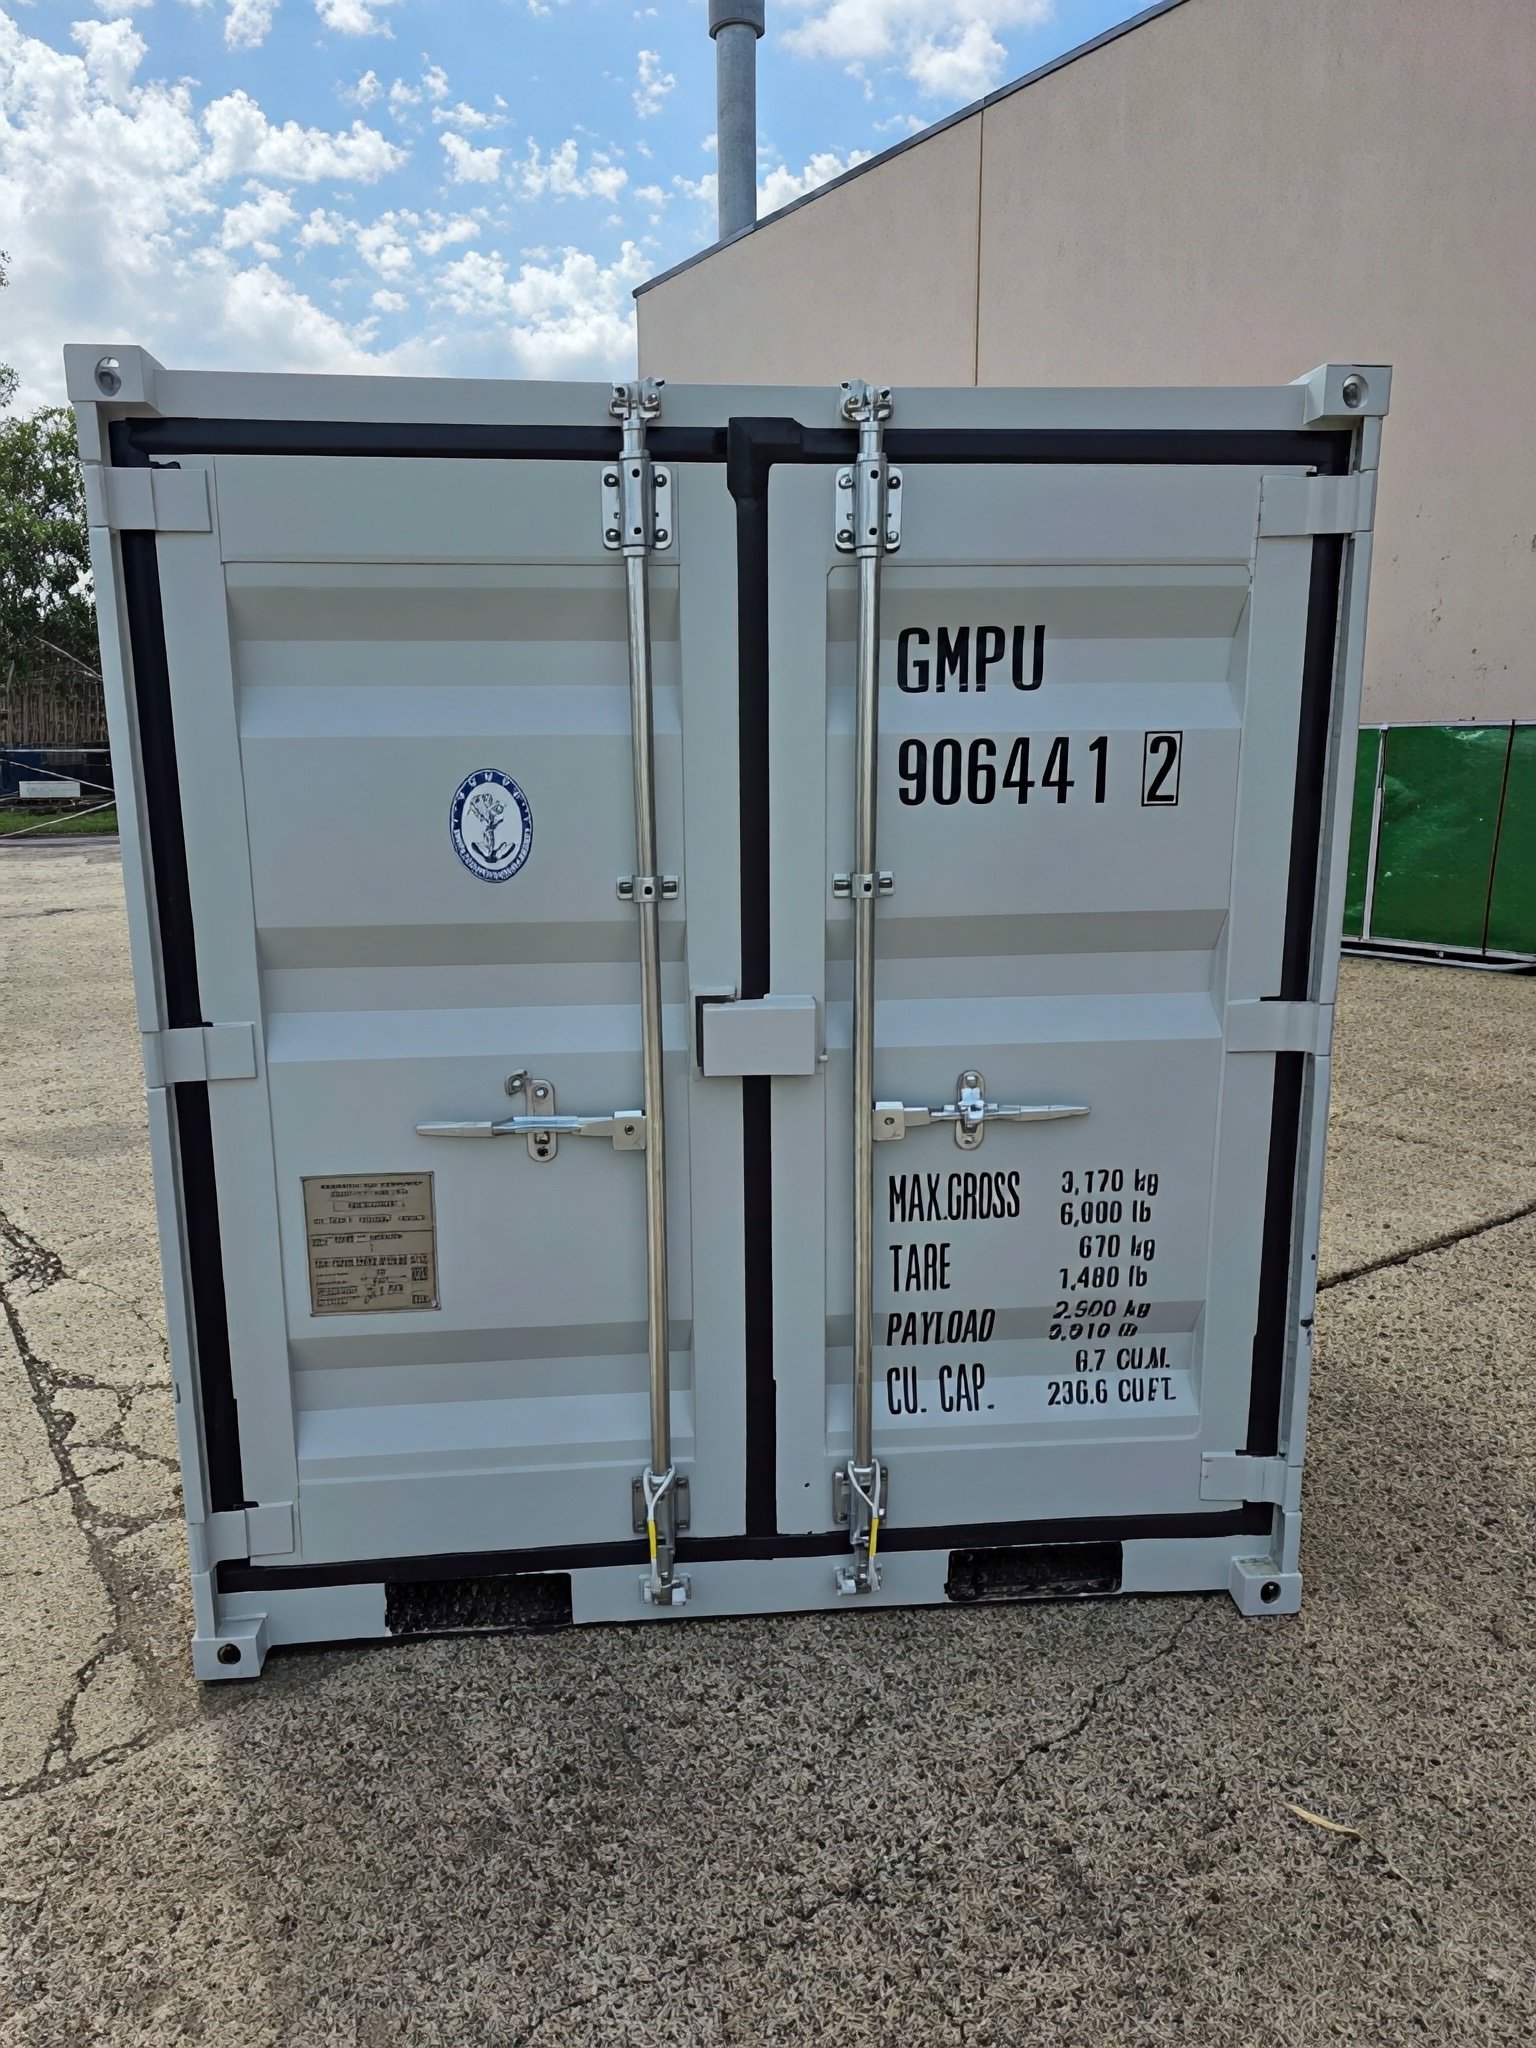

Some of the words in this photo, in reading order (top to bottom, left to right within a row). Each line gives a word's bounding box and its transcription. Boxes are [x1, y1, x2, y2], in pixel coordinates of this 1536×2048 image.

[897, 625, 1046, 693] GMPU
[899, 736, 1109, 806] 906441
[1146, 735, 1179, 803] 2
[1062, 1169, 1124, 1196] 3,170
[1135, 1168, 1158, 1196] kg
[1132, 1200, 1151, 1223] lb
[1079, 1235, 1121, 1258] 670
[889, 1243, 951, 1292] TARE
[1128, 1265, 1148, 1287] lb
[886, 1309, 996, 1346] PAYLOAD
[887, 1366, 927, 1415] CU.
[939, 1363, 995, 1412] CAP.
[1048, 1379, 1108, 1406] 236.6
